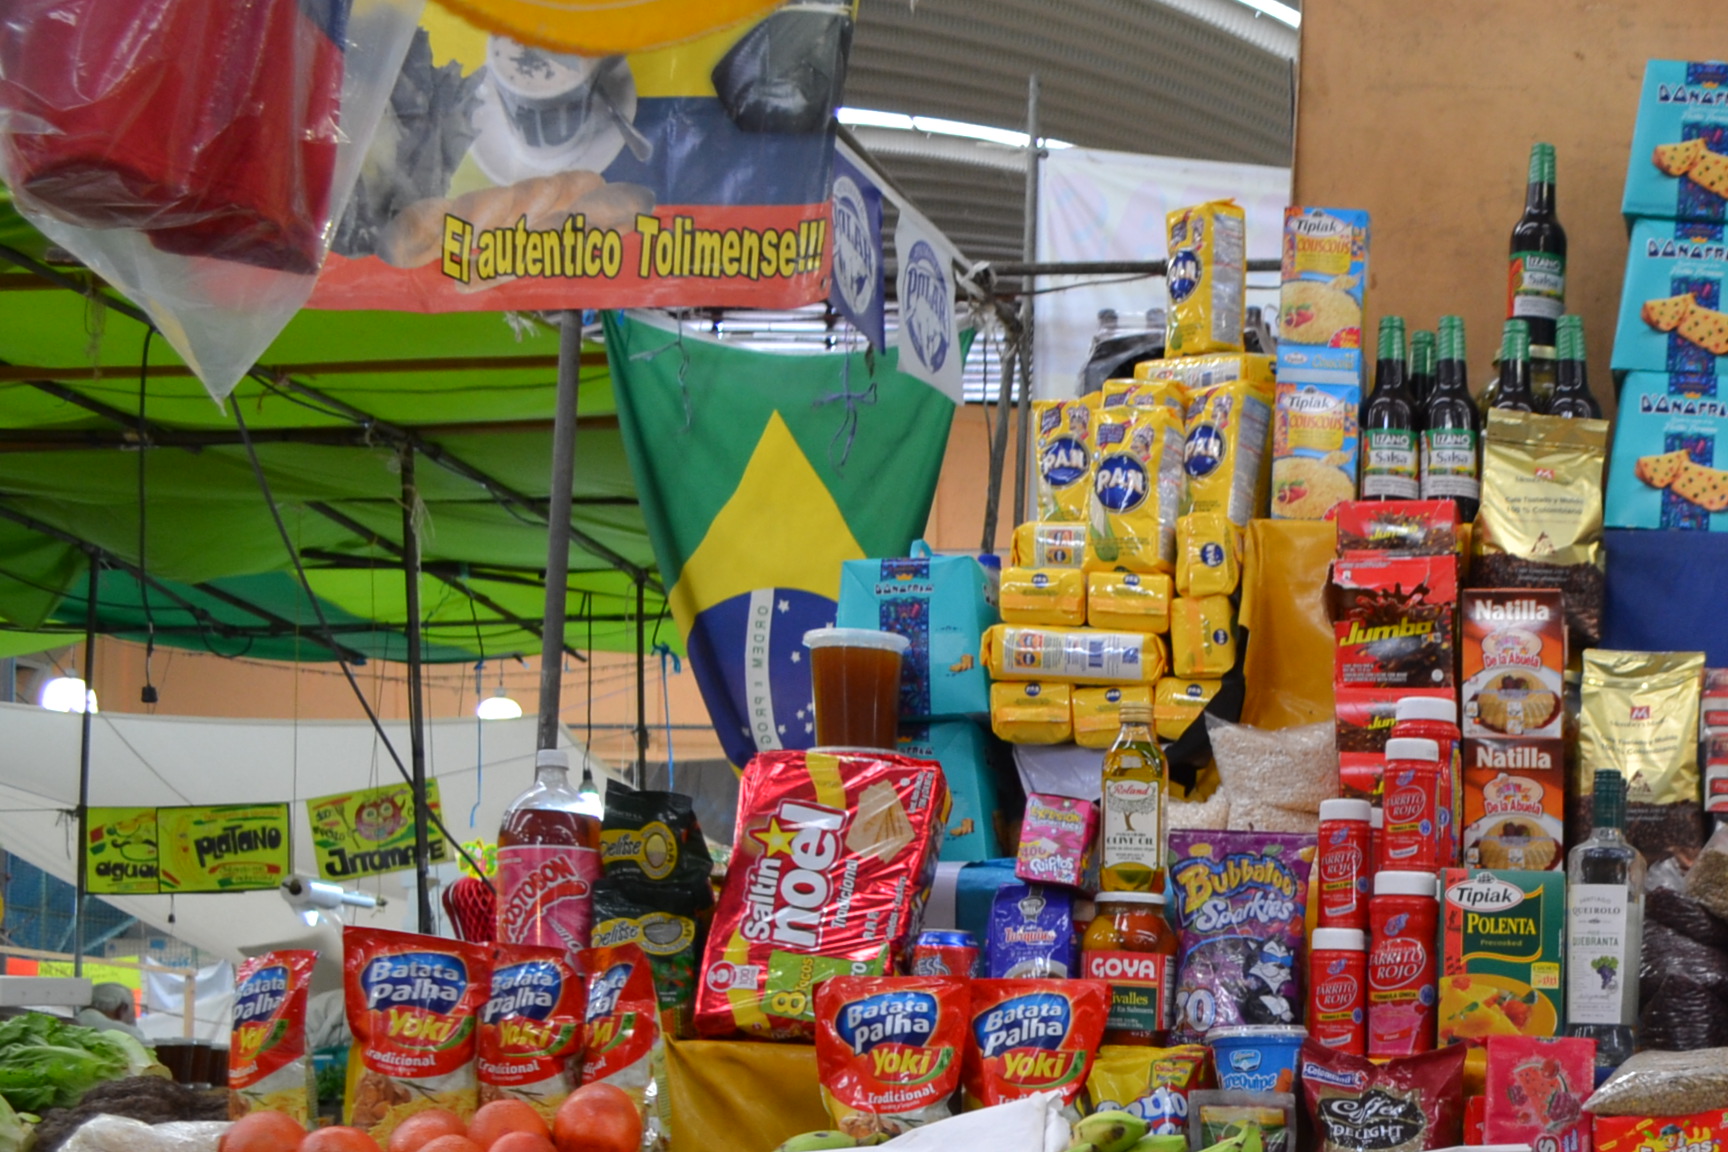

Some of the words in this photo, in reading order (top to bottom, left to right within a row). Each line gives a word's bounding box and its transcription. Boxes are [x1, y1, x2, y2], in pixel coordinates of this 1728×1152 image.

[1296, 219, 1338, 235] Tipiak
[442, 213, 473, 285] El
[477, 214, 622, 280] autentico
[636, 213, 827, 281] Tolimense!!!
[1526, 254, 1562, 270] LIZANO
[1527, 273, 1560, 288] Salsa
[1288, 395, 1331, 411] Tipiak
[1371, 434, 1411, 448] LIZANO
[1433, 434, 1472, 448] LIZANO
[1374, 451, 1409, 465] Salsa
[1434, 451, 1470, 465] Salsa
[1475, 599, 1550, 621] Natilla
[1338, 617, 1435, 647] Jumbo
[1485, 655, 1498, 667] De
[1477, 747, 1553, 770] Natilla
[1113, 783, 1150, 797] Roland
[1392, 803, 1422, 817] ROJO
[1106, 836, 1133, 846] OLIVE
[1138, 836, 1154, 846] OIL
[772, 802, 847, 948] noel
[1177, 857, 1293, 915] Bubbaloo
[830, 858, 860, 930] Tradicional
[1456, 886, 1513, 906] Tipiak
[1196, 890, 1295, 932] Sparkies
[1571, 906, 1622, 917] QUEIROLO
[1466, 913, 1537, 935] POLENTA
[1572, 937, 1619, 947] QUEBRANTA
[369, 961, 460, 984] Batata
[1091, 957, 1156, 979] GOYA
[1377, 963, 1418, 979] ROJO
[366, 978, 460, 1010] palha
[483, 986, 553, 1024] palha
[770, 989, 808, 1016] 8
[387, 1009, 456, 1042] Yoki
[846, 1000, 929, 1029] Batata
[983, 1002, 1062, 1033] Batata
[854, 1011, 930, 1057] palha
[982, 1017, 1064, 1058] palha
[871, 1047, 932, 1078] Yoki
[1003, 1052, 1066, 1080] Yoki
[867, 1083, 936, 1106] Tradicional
[1330, 1090, 1409, 1121] Coffee
[1332, 1123, 1405, 1142] DELIGHT
